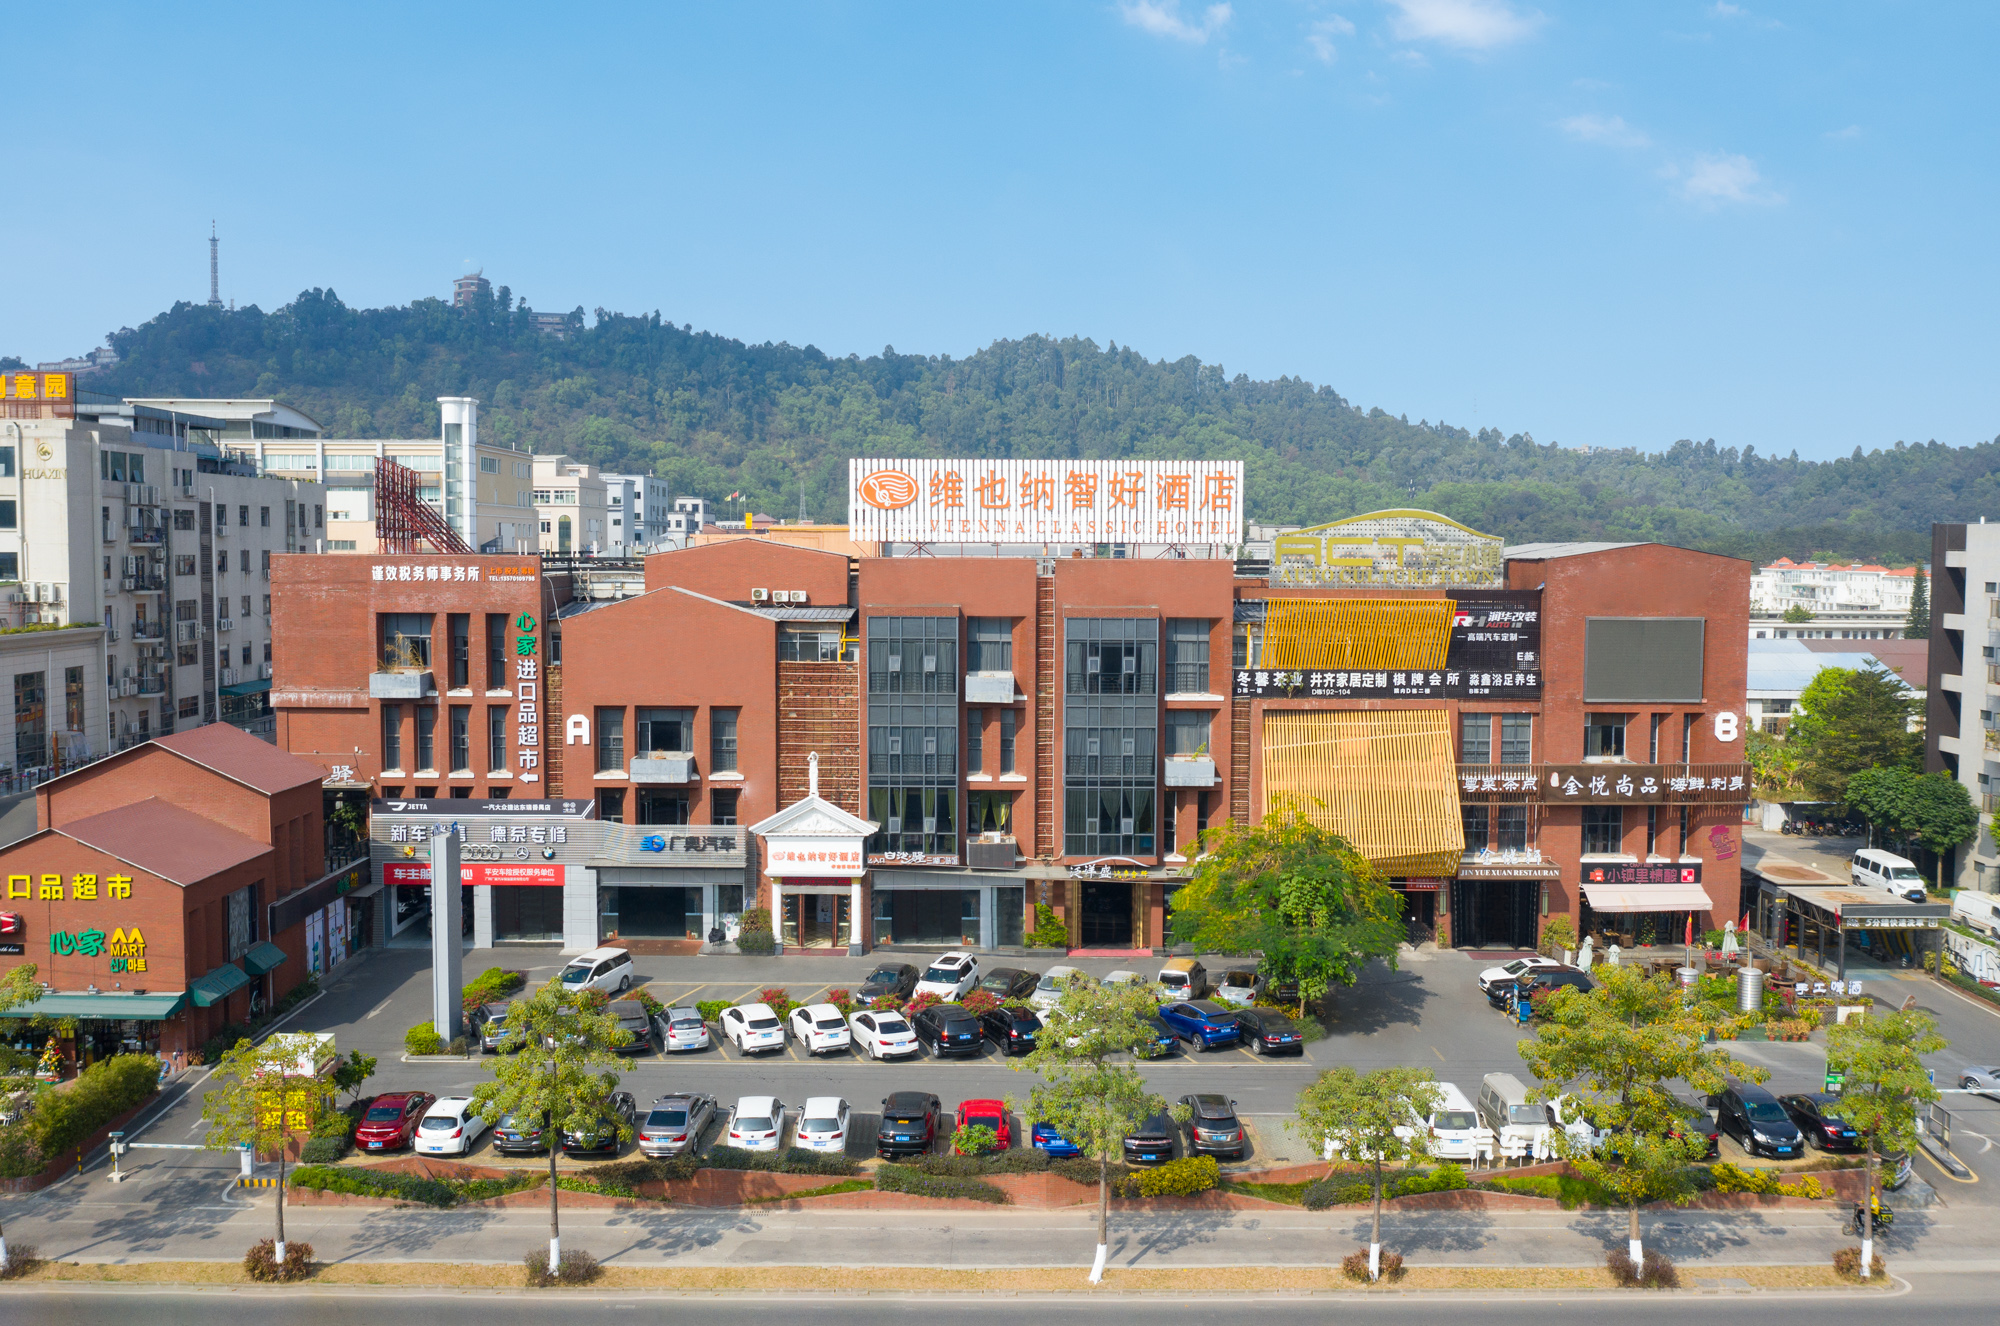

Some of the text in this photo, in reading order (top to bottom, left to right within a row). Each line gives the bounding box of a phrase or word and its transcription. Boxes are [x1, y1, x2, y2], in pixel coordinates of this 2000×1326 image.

[23, 468, 67, 480] HUAXIN
[929, 470, 1236, 511] 维也纳智好酒店
[930, 519, 1235, 535] VIENNA CLASSIC HOTEL
[1423, 545, 1500, 568] 汽车小镇
[372, 566, 479, 582] 谨效税务师事务所
[1279, 568, 1495, 585] AUTO CULTURE TOWN
[1488, 611, 1537, 622] 润华改装
[1467, 633, 1518, 642] 高端汽车定制
[1310, 672, 1387, 688] 井齐家居定制
[1393, 673, 1460, 687] 棋牌会所
[1469, 673, 1537, 687] 淼鑫浴足养生
[566, 714, 591, 745] A
[1562, 775, 1659, 796] 金悦尚品
[490, 825, 567, 844] 德系专修
[485, 868, 555, 877] 平安车险授权服务单位
[1608, 868, 1678, 883] 小镇里精酿
[50, 928, 106, 956] 心家
[110, 944, 146, 956] MART
[1795, 981, 1862, 995] 手工啤酒
